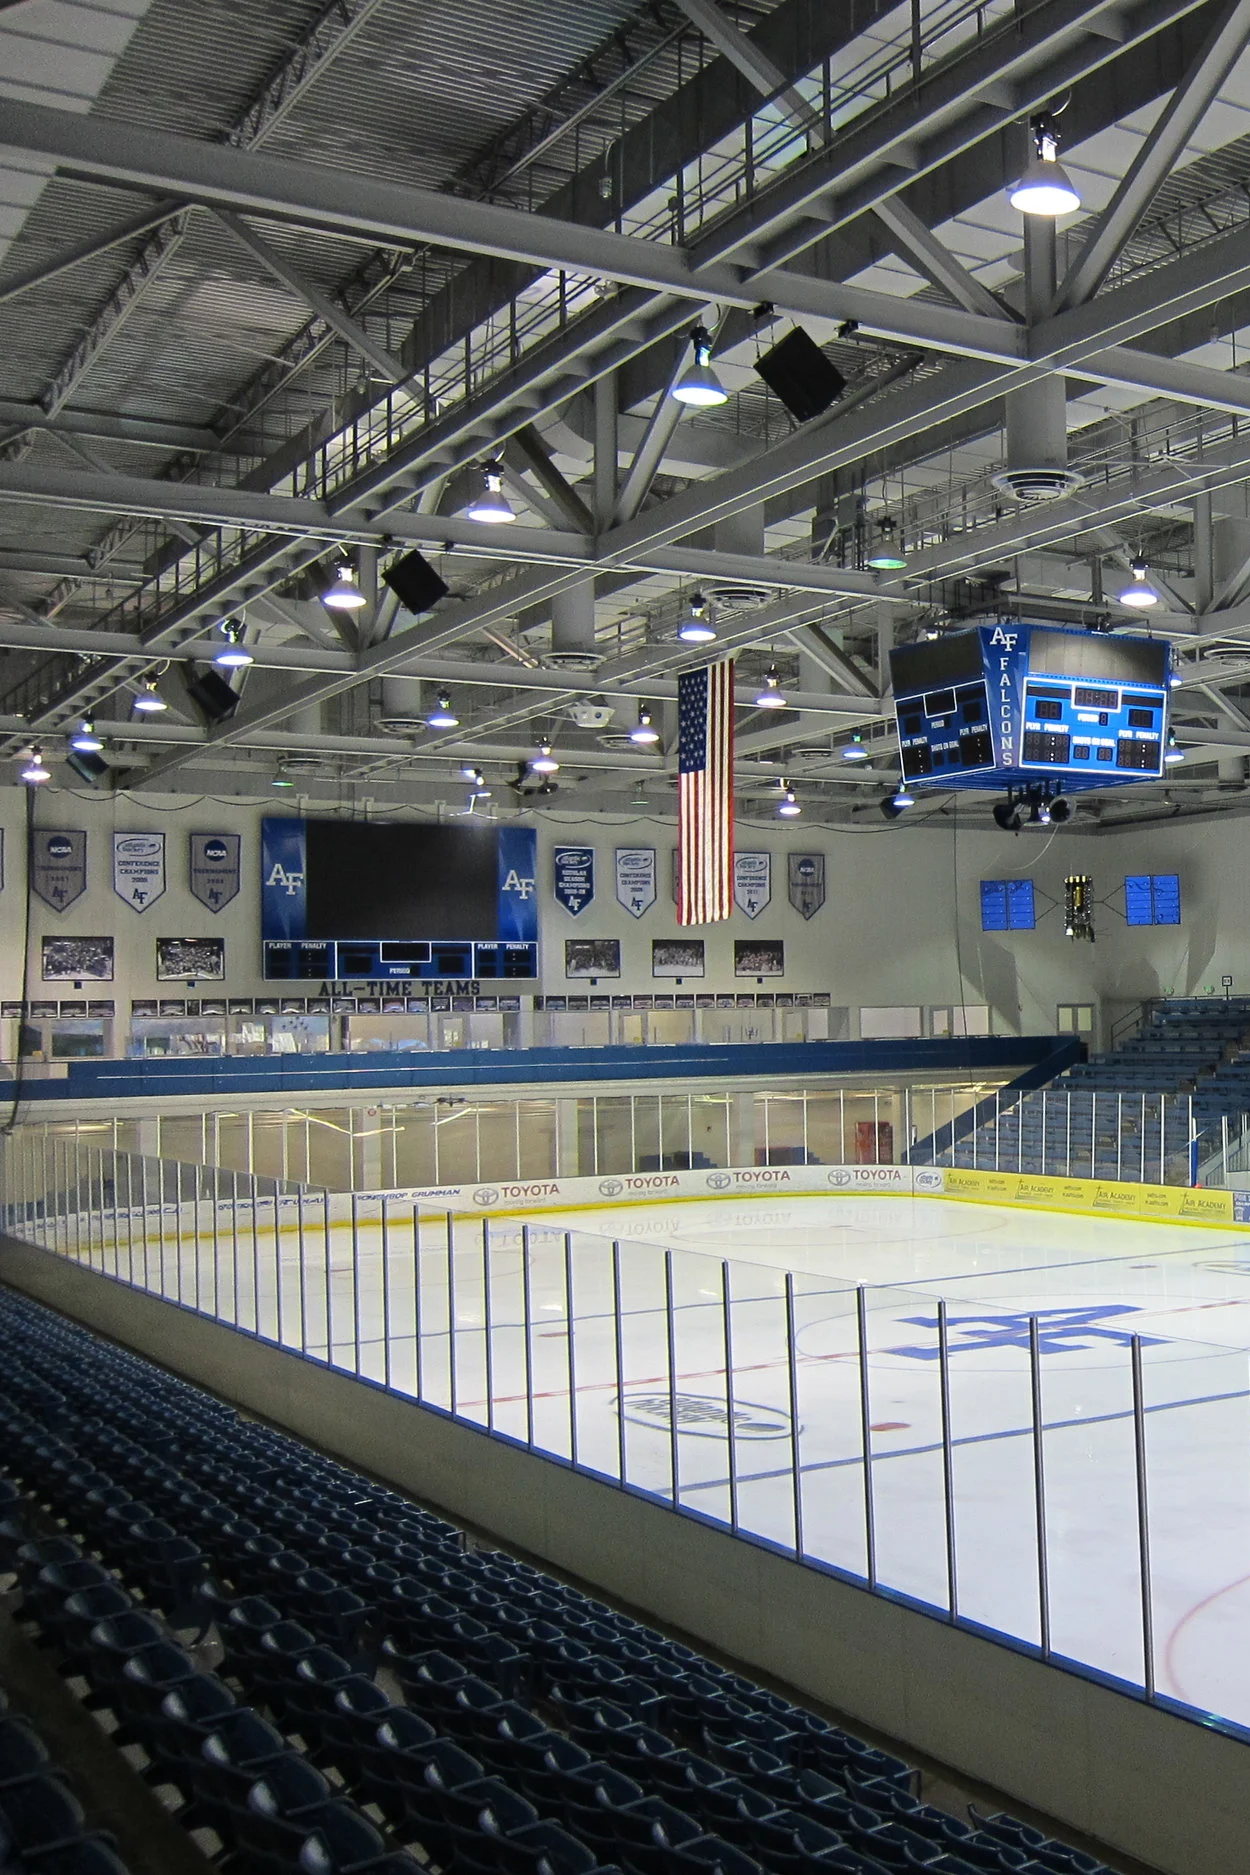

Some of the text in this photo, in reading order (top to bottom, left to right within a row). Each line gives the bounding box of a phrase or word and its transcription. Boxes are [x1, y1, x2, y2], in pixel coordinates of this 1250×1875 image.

[990, 627, 1018, 652] AF
[1000, 657, 1014, 766] FALCONS
[971, 724, 988, 734] PENALTY
[1044, 723, 1069, 733] PENALTY
[912, 736, 928, 745] PENALTY
[1136, 731, 1159, 741] PENALTY
[948, 740, 960, 749] GOAL
[1100, 738, 1116, 747] GOAL
[50, 846, 72, 854] NCAA
[206, 849, 227, 857] NCAA
[265, 863, 304, 895] AF
[502, 869, 535, 899] AF
[132, 888, 148, 904] AF
[318, 981, 480, 996] ALL-TIME TEAMS
[733, 1171, 791, 1182] TOYOTA
[852, 1169, 901, 1180] TOYOTA
[625, 1176, 680, 1189] TOYOTA
[411, 1189, 461, 1198] GRUMMAN
[502, 1184, 560, 1198] TOYOTA
[1030, 1185, 1054, 1193] ACADEMY
[1099, 1191, 1136, 1201] AIR ACADEMY
[1185, 1199, 1226, 1209] AIR ACADEMY
